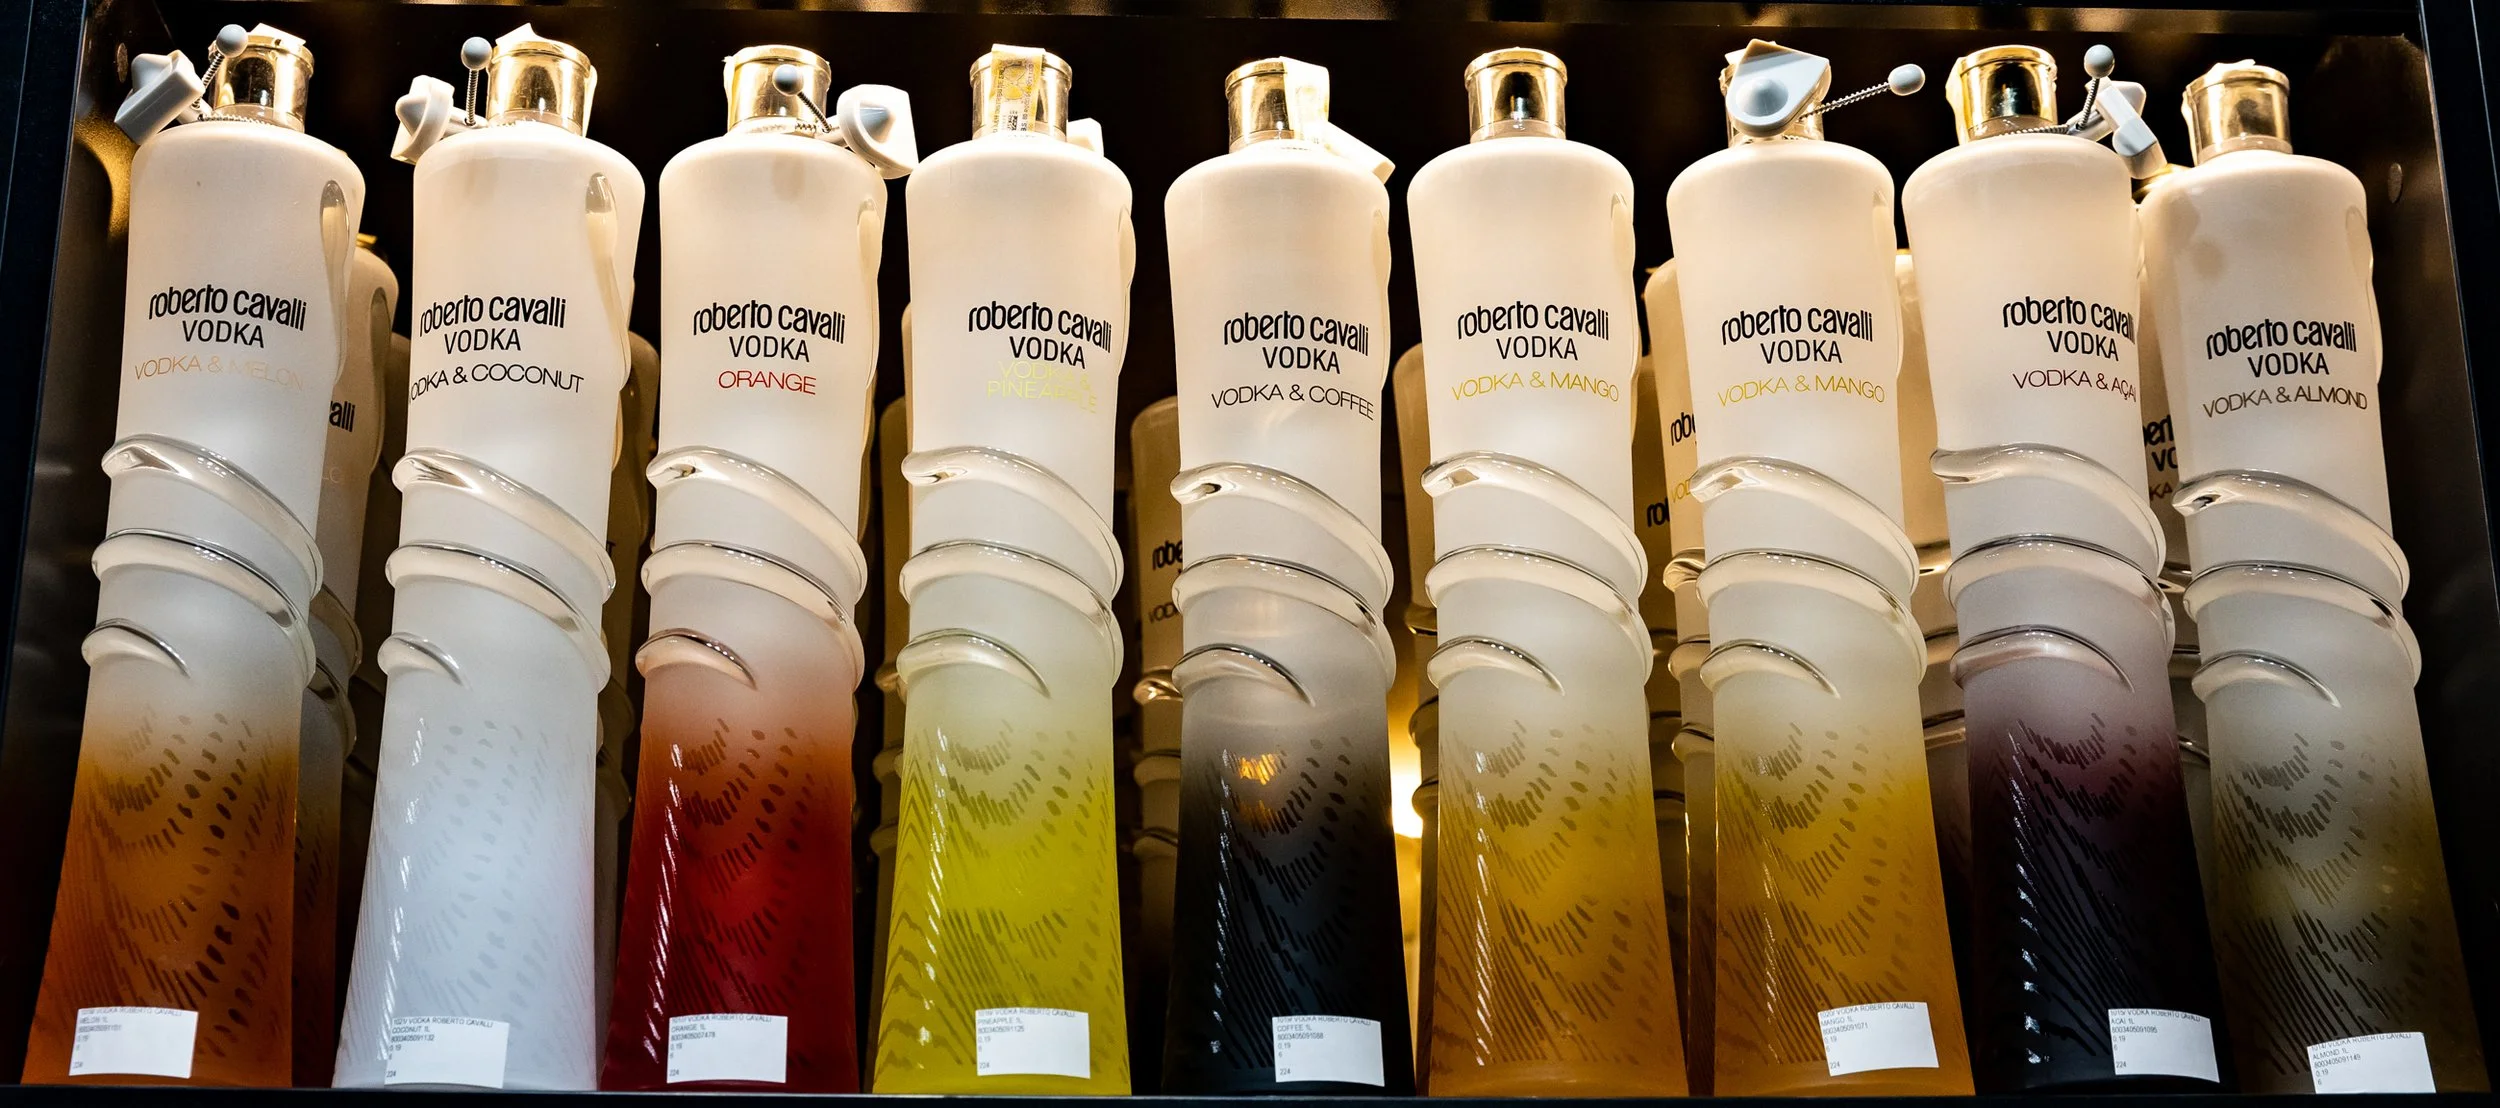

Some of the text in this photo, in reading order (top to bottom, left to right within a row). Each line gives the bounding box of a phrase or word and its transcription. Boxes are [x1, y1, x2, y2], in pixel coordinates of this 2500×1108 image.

[149, 284, 306, 331] roberto cavalli
[420, 295, 566, 337] roberto cavalli
[694, 300, 845, 344] roberto cavalli
[1458, 301, 1609, 341] roberto cavalli
[2003, 296, 2136, 345] roberto cavalli
[182, 320, 264, 348] VODKA
[445, 328, 521, 354] VODKA
[969, 301, 1112, 354] roberto cavalli
[1224, 311, 1369, 357] roberto cavalli
[1722, 305, 1873, 346] roberto cavalli
[2206, 318, 2357, 360] roberto cavalli
[729, 335, 809, 362] VODKA
[1009, 336, 1085, 369] VODKA
[1262, 346, 1340, 374] VODKA
[1496, 336, 1578, 360] VODKA
[1760, 340, 1842, 364] VODKA
[2047, 331, 2118, 361] VODKA
[135, 355, 202, 380] VODKA
[208, 356, 223, 374] &
[2012, 370, 2092, 389] VODKA
[2096, 373, 2109, 391] &
[2247, 352, 2329, 377] VODKA
[411, 364, 584, 400] ODKA & COCONUT
[719, 370, 816, 395] ORANGE
[1452, 371, 1619, 402] VODKA & MANGO
[1718, 375, 1885, 407] VODKA & MANGO
[1212, 384, 1373, 420] VODKA & COFFEE
[2203, 385, 2367, 418] VODKA & ALMOND
